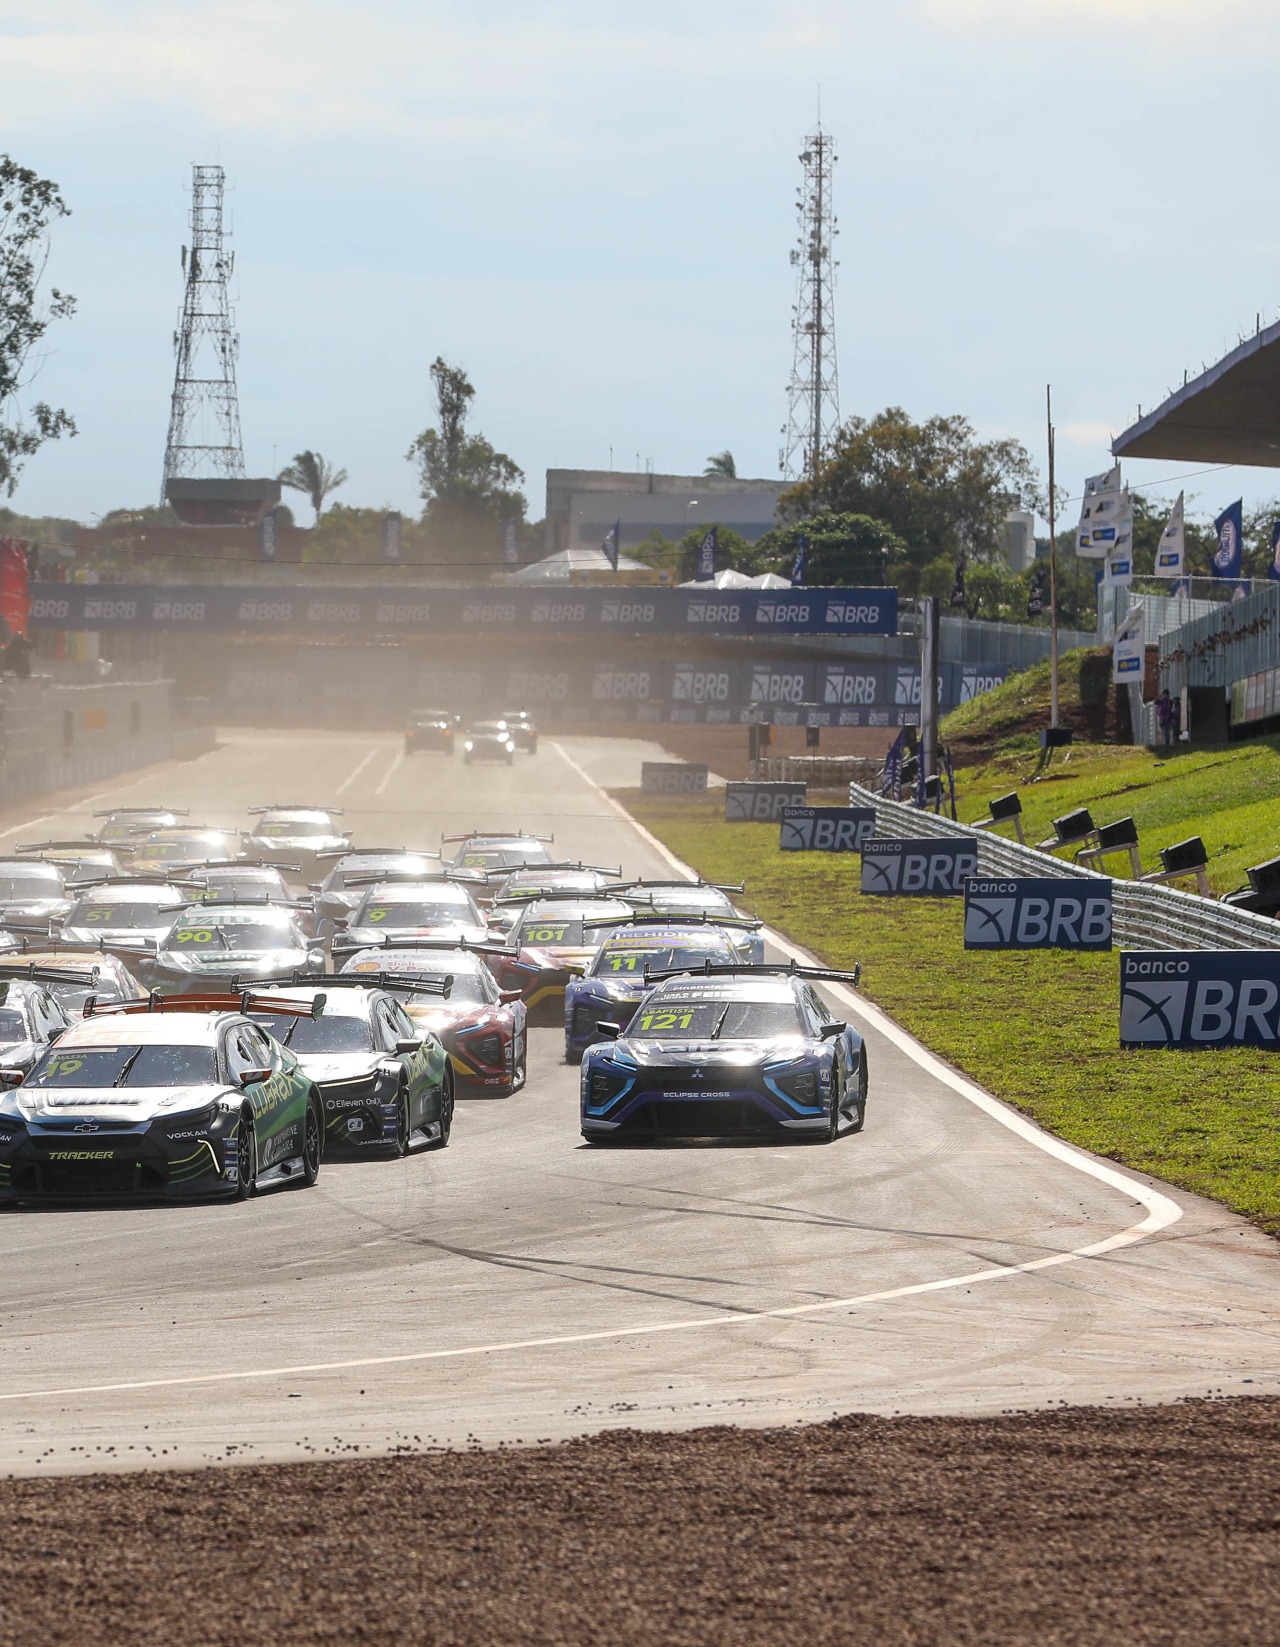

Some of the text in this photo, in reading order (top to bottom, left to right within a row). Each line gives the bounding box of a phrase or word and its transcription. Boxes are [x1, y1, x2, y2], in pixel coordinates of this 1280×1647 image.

[619, 604, 655, 622] BRB
[705, 605, 741, 622] BRB
[774, 606, 810, 622] BRB
[844, 606, 880, 623] BRB
[692, 673, 729, 699] BRB
[770, 675, 804, 701] BRB
[841, 676, 876, 703] BRB
[666, 773, 706, 793] BRB
[784, 808, 815, 817] banco
[864, 842, 902, 852] banco
[901, 854, 978, 891] BRB
[969, 881, 1018, 893] banco
[86, 911, 113, 922] 51
[370, 911, 387, 923] 9
[1016, 898, 1113, 943] BRB
[176, 931, 213, 944] 90
[526, 930, 565, 942] 101
[609, 958, 637, 970] 11
[1125, 958, 1190, 974] banco
[1190, 979, 1280, 1041] BR
[639, 1014, 694, 1031] 121
[46, 1059, 83, 1077] 19
[166, 1129, 208, 1140] VOCKAN
[48, 1151, 114, 1160] TRACKER
